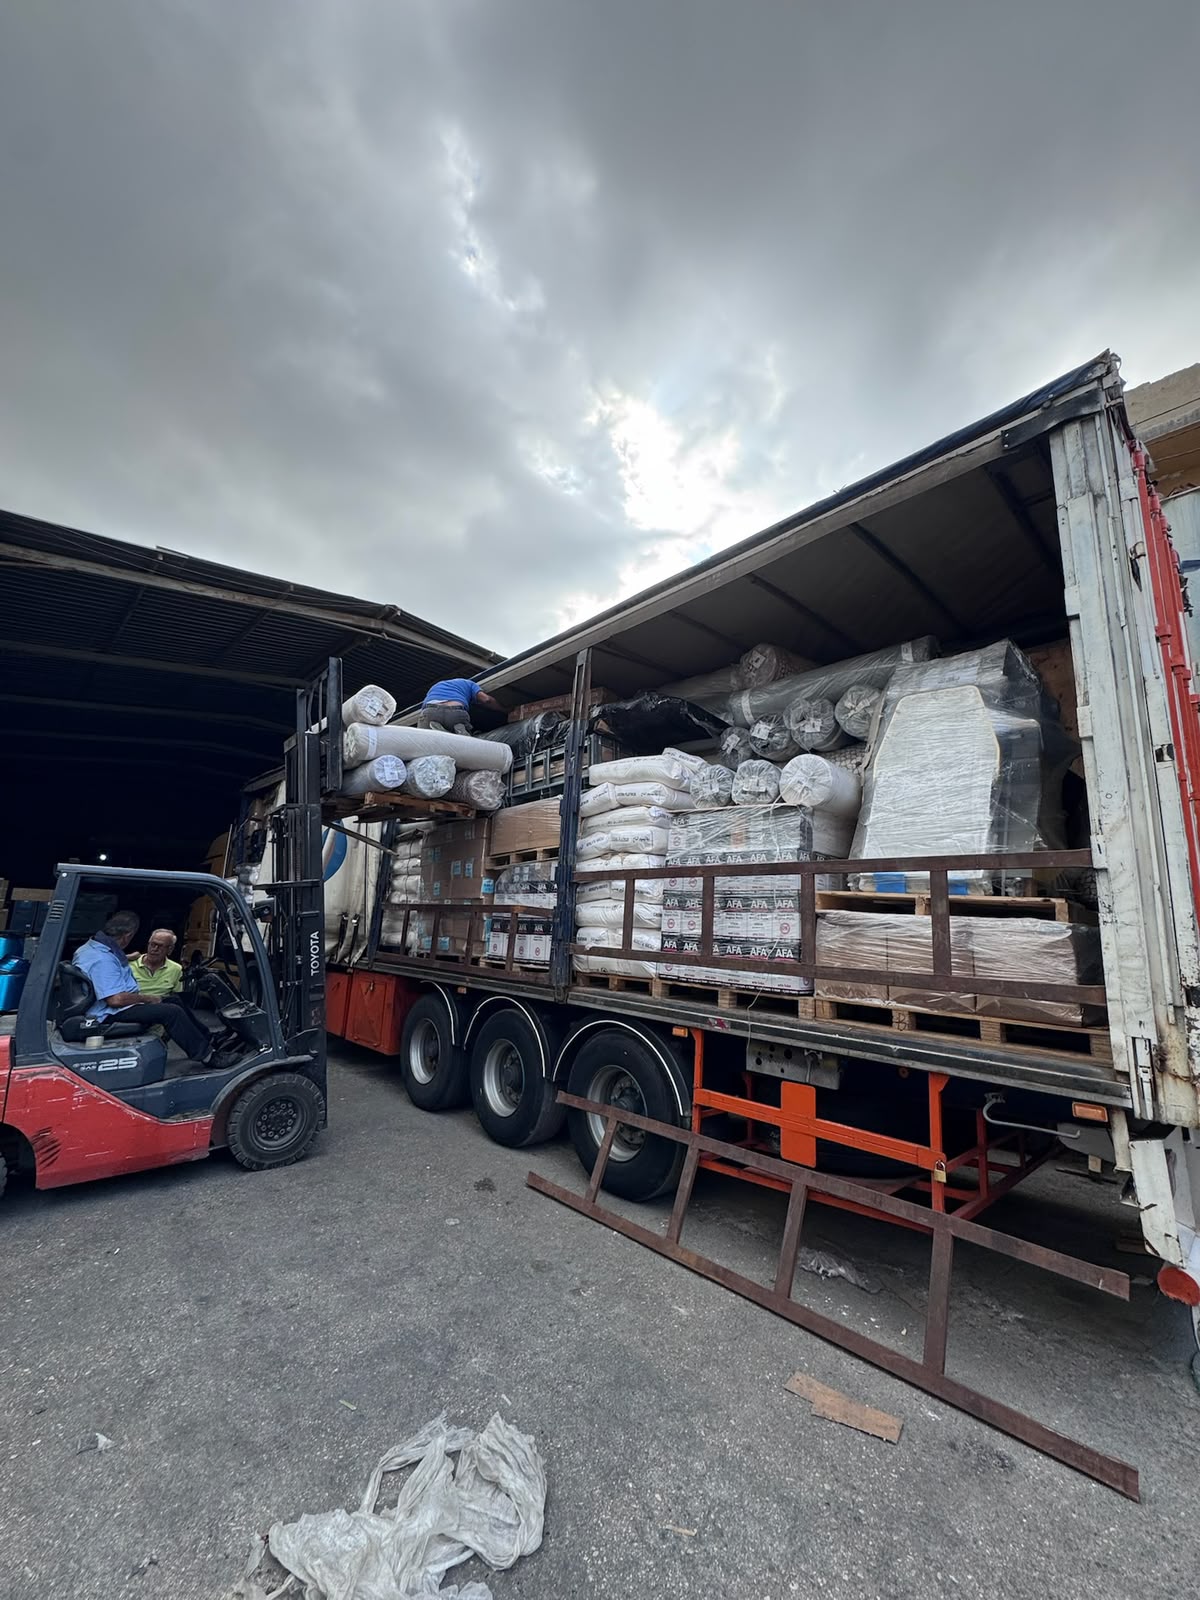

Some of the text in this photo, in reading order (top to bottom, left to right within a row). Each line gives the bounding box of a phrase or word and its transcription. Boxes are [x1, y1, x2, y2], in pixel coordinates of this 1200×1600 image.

[668, 857, 681, 865] AFA
[687, 857, 701, 865] AFA
[706, 855, 720, 864] AFA
[727, 854, 743, 863] AFA
[750, 853, 766, 862] AFA
[775, 852, 792, 861] AFA
[799, 852, 810, 862] AFA
[665, 898, 679, 907] AFA
[726, 900, 743, 908] AFA
[751, 900, 768, 909] AFA
[776, 899, 794, 908] AFA
[663, 940, 677, 949] AFA
[683, 942, 698, 952] AFA
[310, 930, 320, 977] TOYOTA
[726, 945, 742, 955] AFA
[750, 947, 767, 957] AFA
[775, 949, 794, 958] AFA
[97, 1056, 138, 1072] 25
